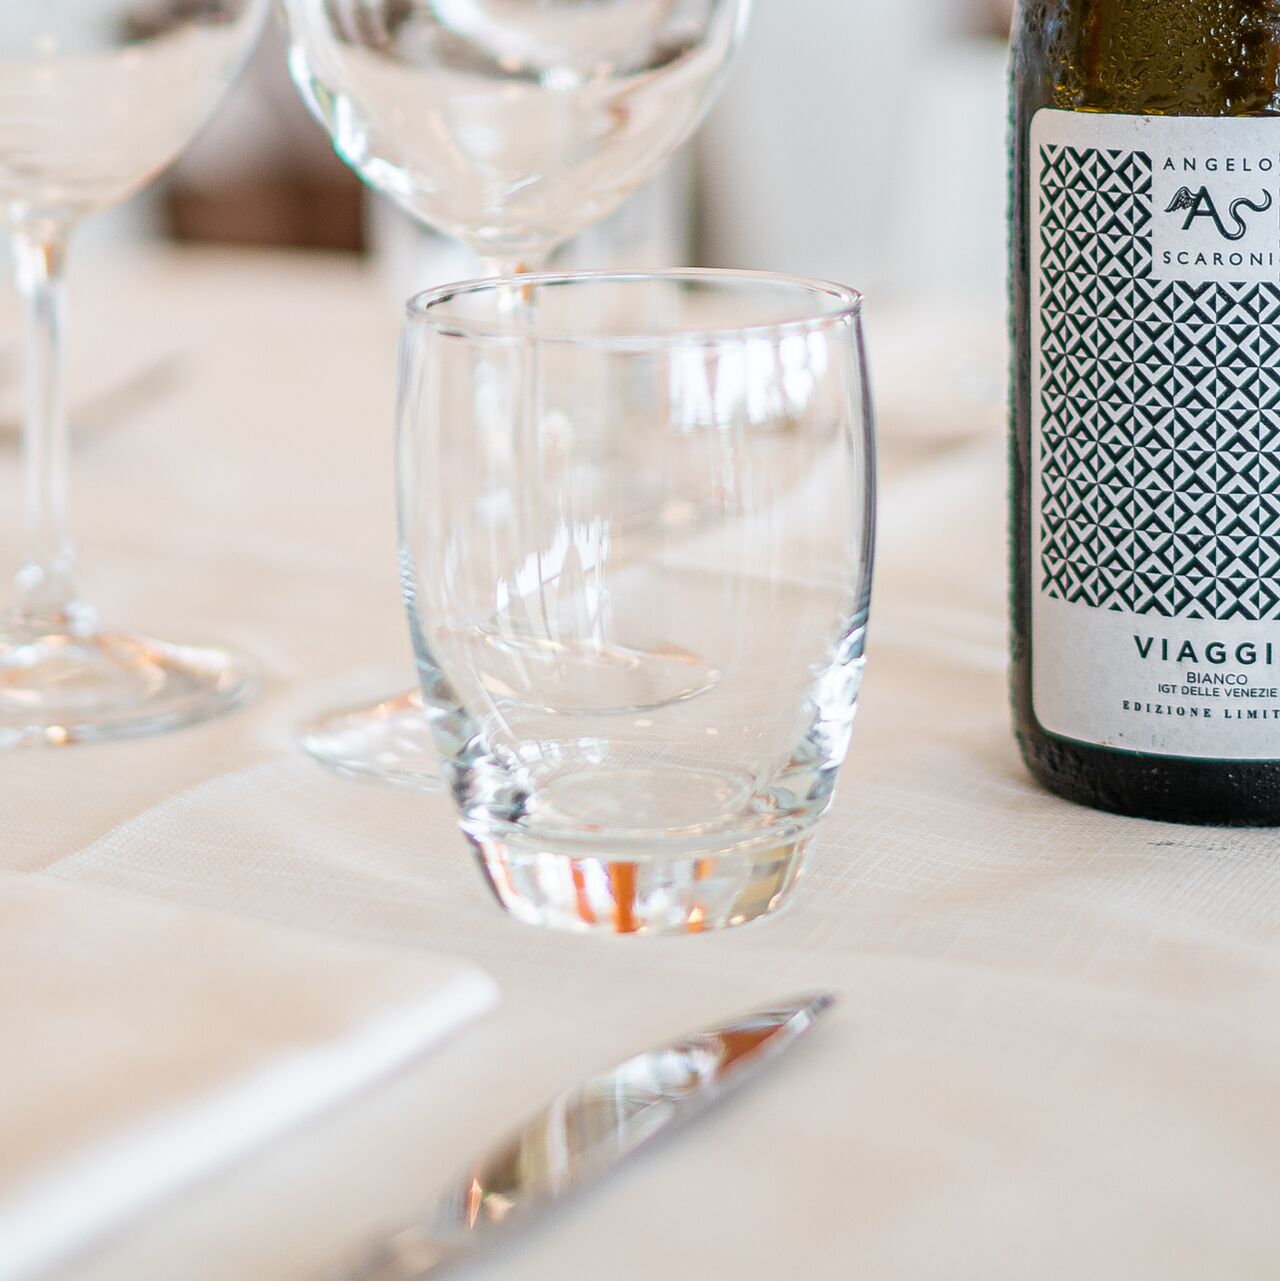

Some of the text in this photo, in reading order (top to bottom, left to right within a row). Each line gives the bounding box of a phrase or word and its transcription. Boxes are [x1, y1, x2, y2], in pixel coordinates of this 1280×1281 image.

[1163, 157, 1272, 171] ANGELO
[1163, 251, 1272, 265] SCARONI
[1186, 671, 1248, 686] BIANCO
[1157, 683, 1278, 698] IGT DELLE VENEZIE
[1122, 700, 1212, 718] EDIZIONE
